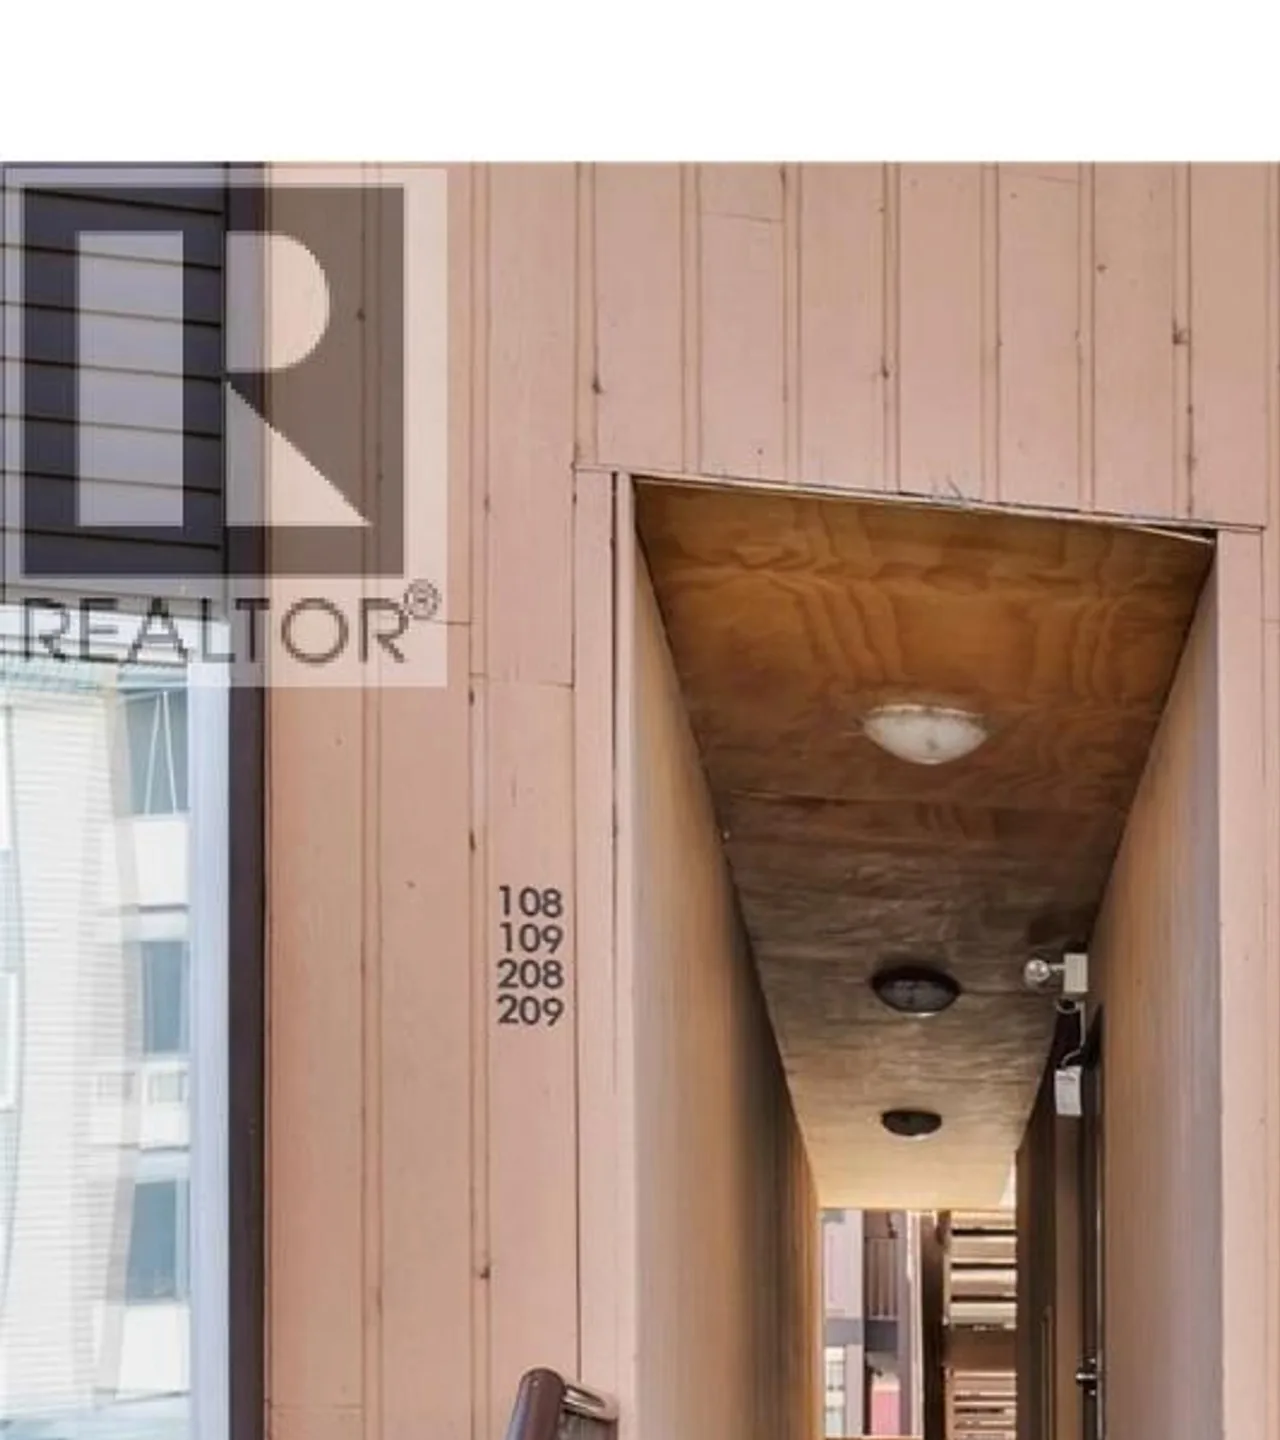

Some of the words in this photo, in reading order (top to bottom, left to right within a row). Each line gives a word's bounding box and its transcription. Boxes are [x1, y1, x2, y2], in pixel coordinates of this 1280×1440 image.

[499, 884, 564, 918] 108
[499, 921, 564, 955] 109
[497, 958, 564, 990] 208
[496, 993, 564, 1027] 209
